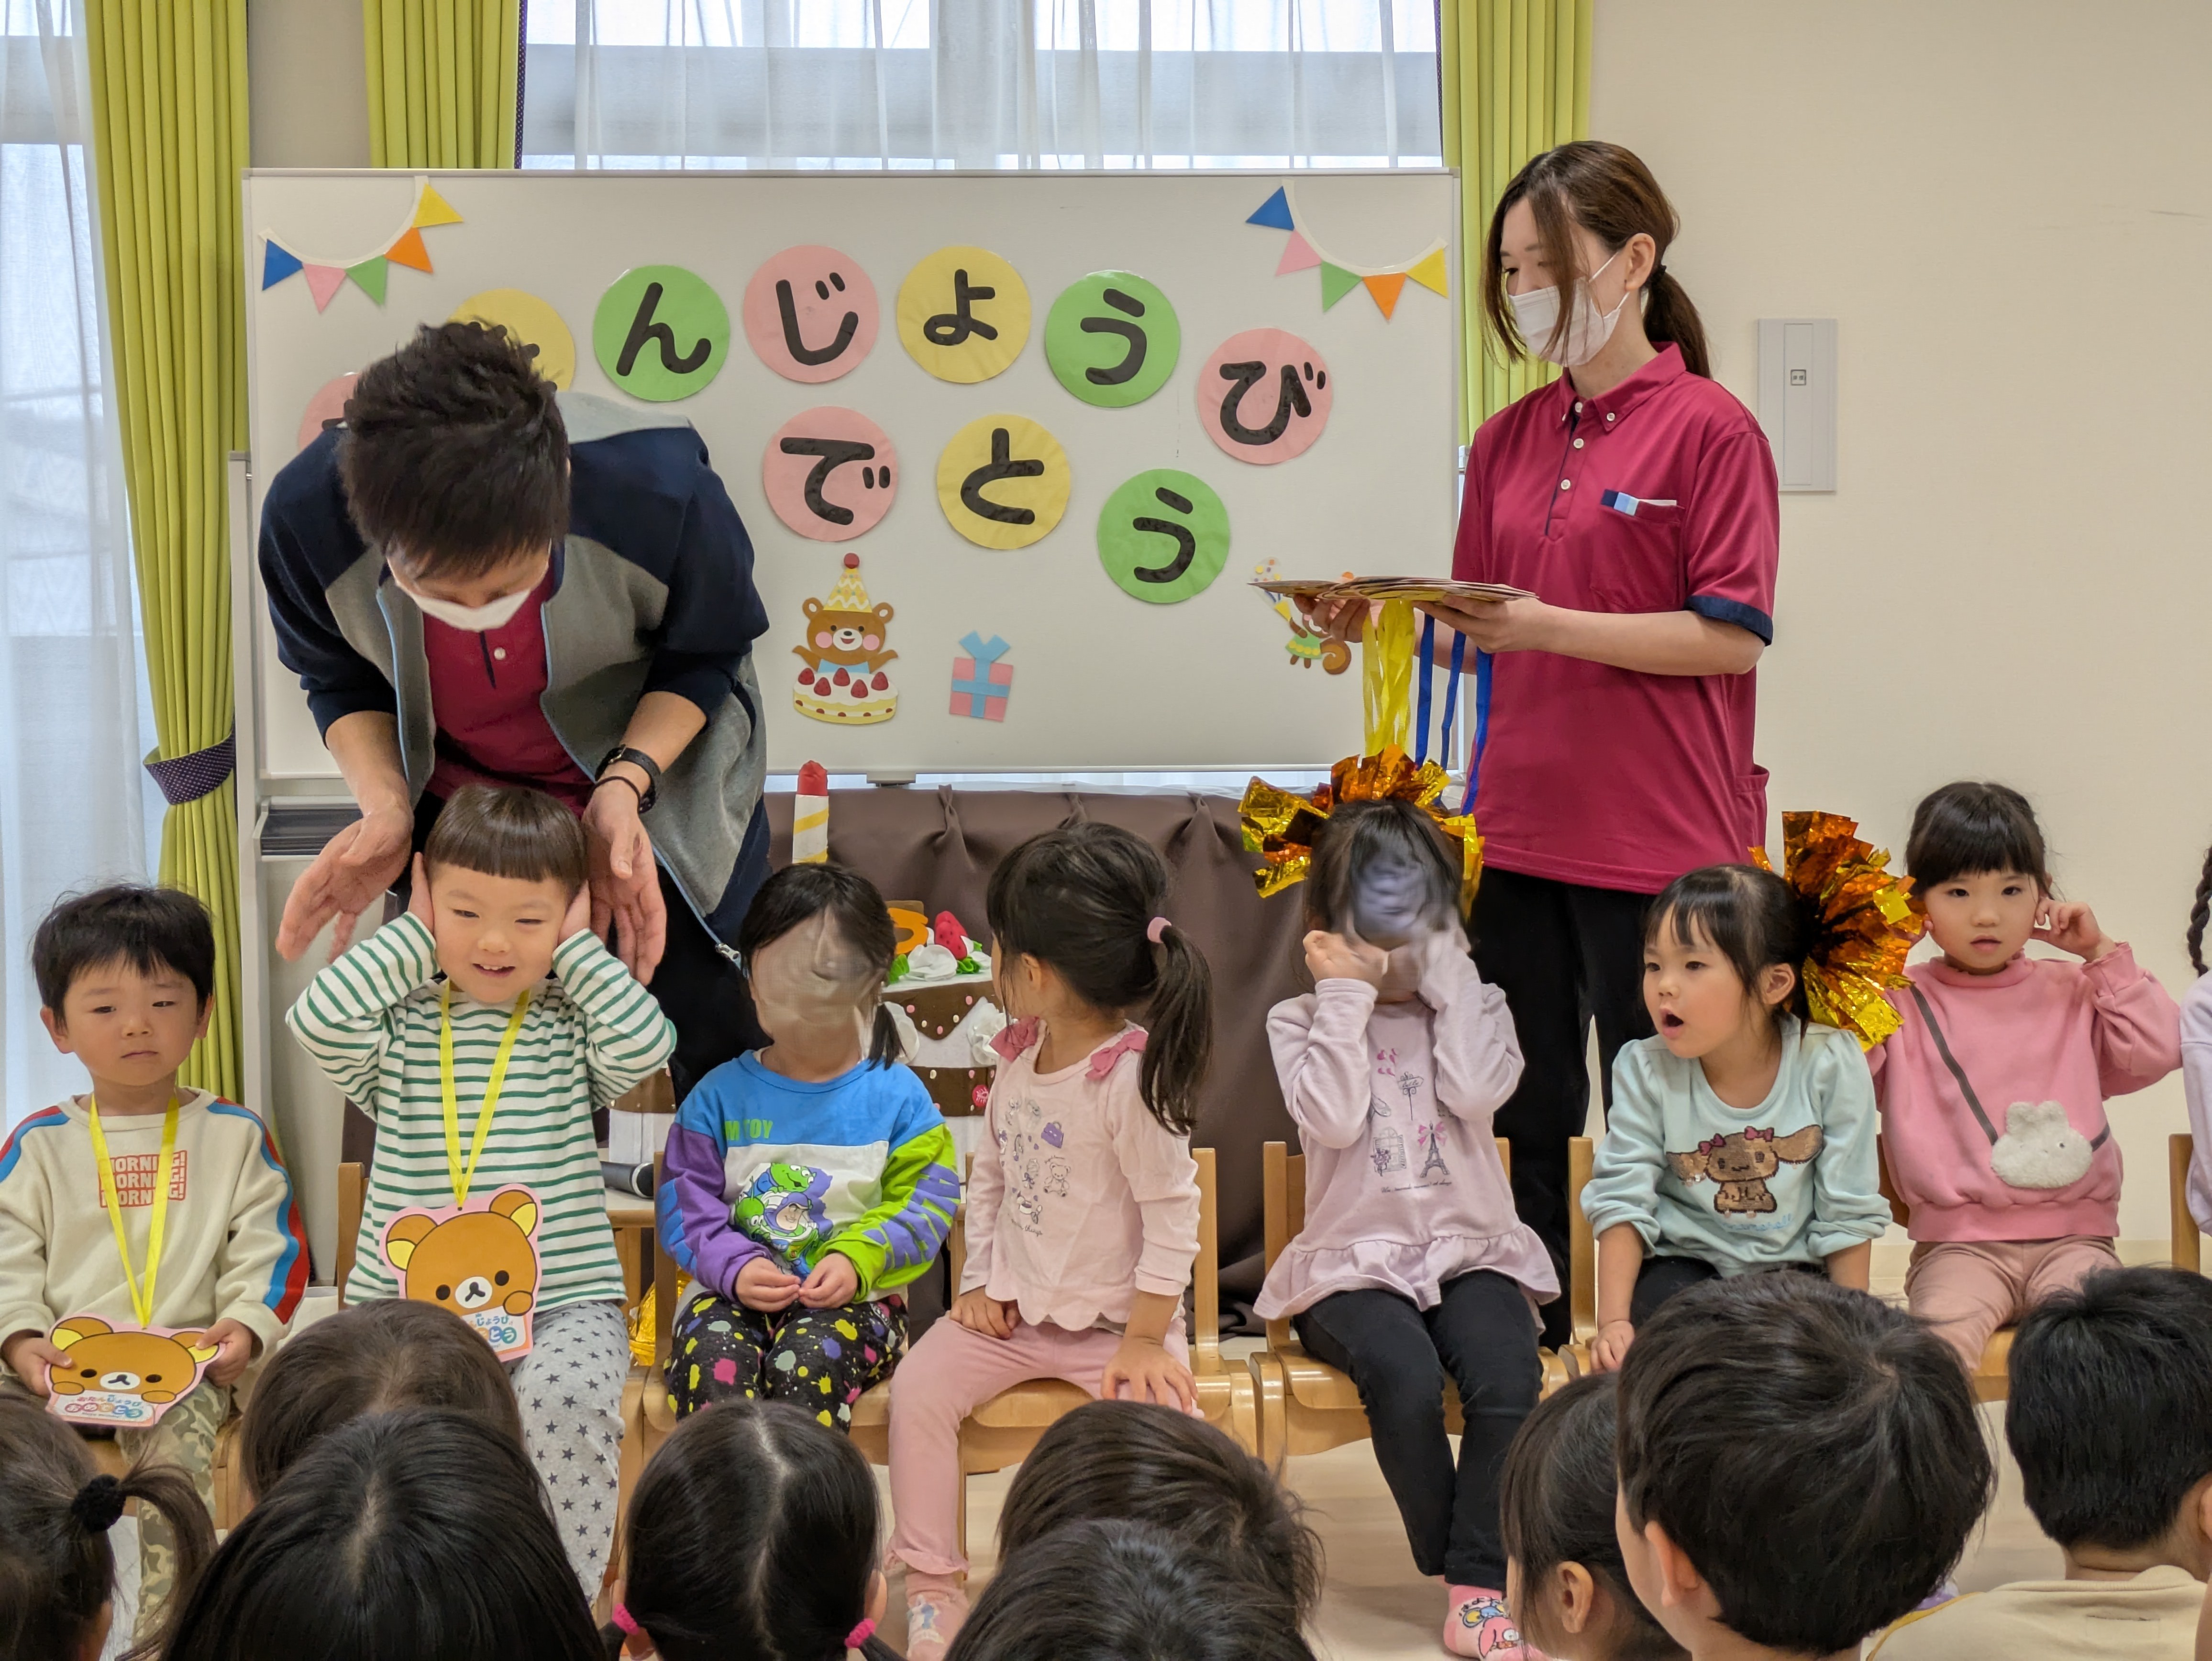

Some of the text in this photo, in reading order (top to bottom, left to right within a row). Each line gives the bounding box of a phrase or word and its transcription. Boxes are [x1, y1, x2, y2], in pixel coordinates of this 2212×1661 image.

[321, 268, 1327, 446] んじょうび
[110, 1152, 186, 1172] ORNIG!
[100, 1167, 185, 1189] ORNIG!
[101, 1183, 185, 1206] ORNG!
